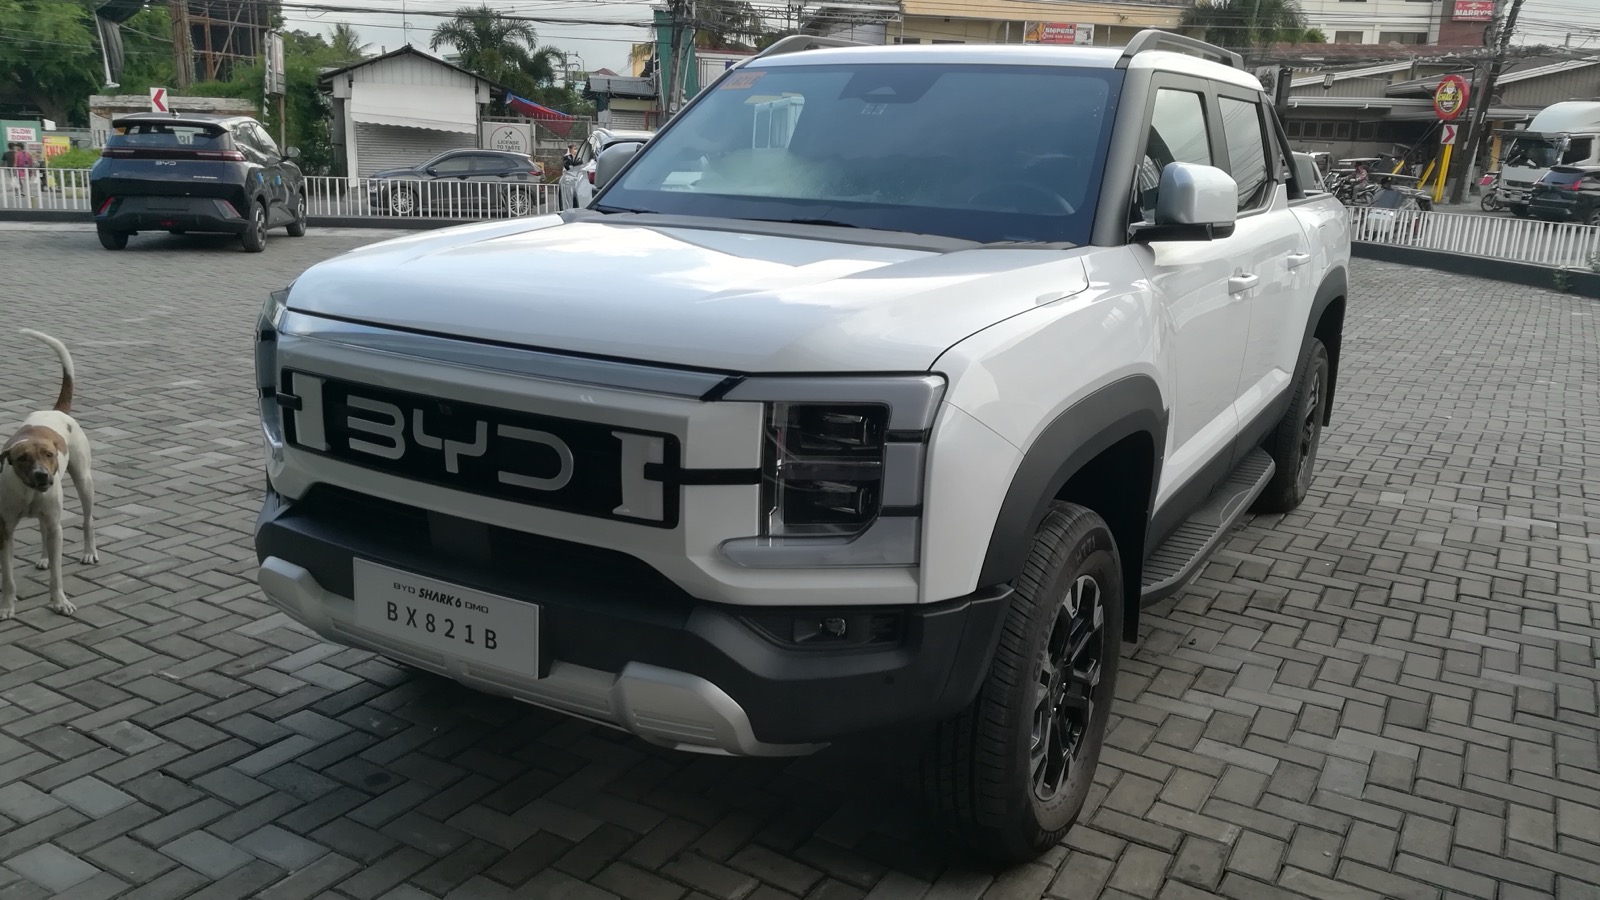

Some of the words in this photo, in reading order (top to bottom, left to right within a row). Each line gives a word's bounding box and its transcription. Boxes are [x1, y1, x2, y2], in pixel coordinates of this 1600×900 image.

[346, 394, 574, 491] BYD
[393, 582, 416, 594] BYD
[418, 588, 454, 607] SHARK
[455, 597, 462, 608] 6
[464, 601, 489, 614] DMO
[387, 601, 497, 650] BX821B
